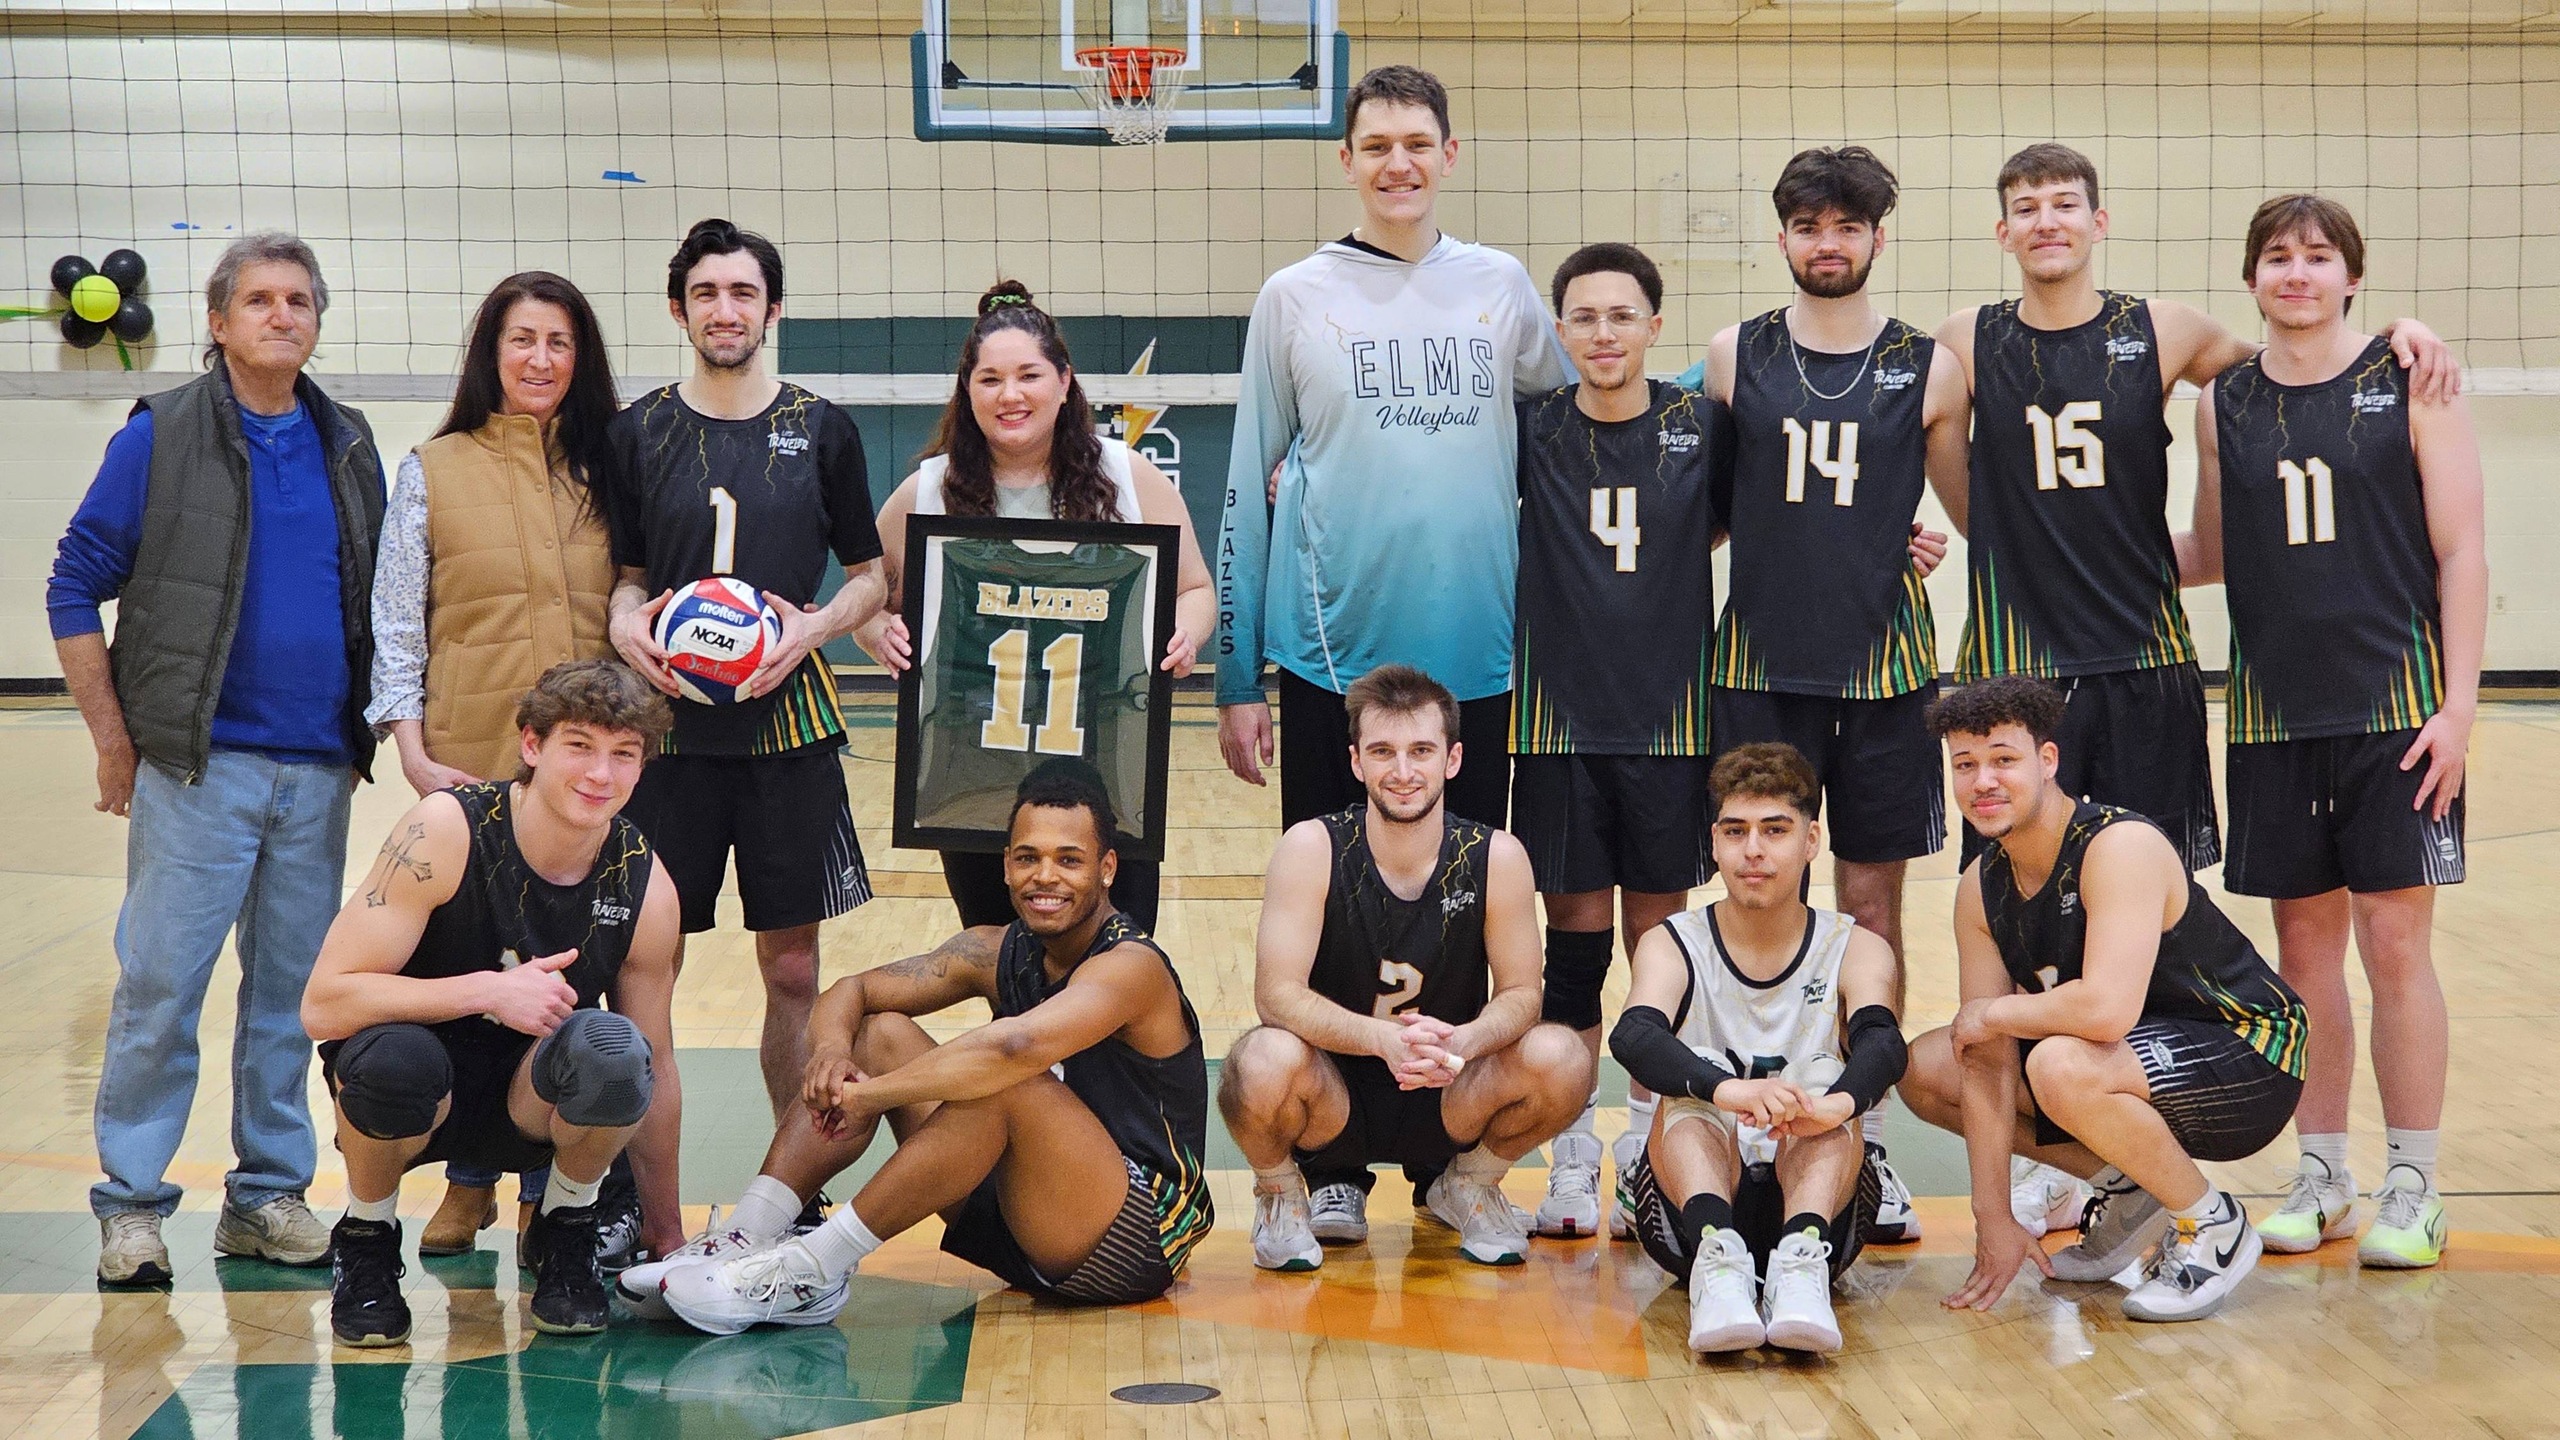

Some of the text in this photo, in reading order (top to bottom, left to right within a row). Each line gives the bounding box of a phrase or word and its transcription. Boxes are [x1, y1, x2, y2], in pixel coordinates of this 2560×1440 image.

[1351, 337, 1495, 399] ELMS
[1375, 403, 1480, 436] Volleyball
[2025, 400, 2106, 491] 15
[1782, 417, 1860, 508] 14
[2277, 456, 2336, 546] 11
[708, 486, 738, 574] 1
[1218, 488, 1238, 656] BLAZERS
[1589, 487, 1641, 572] 4
[690, 625, 735, 652] NCAA
[698, 602, 745, 625] molten
[976, 582, 1110, 621] BLAZERS
[981, 629, 1085, 756] 11
[1374, 960, 1425, 1020] 2
